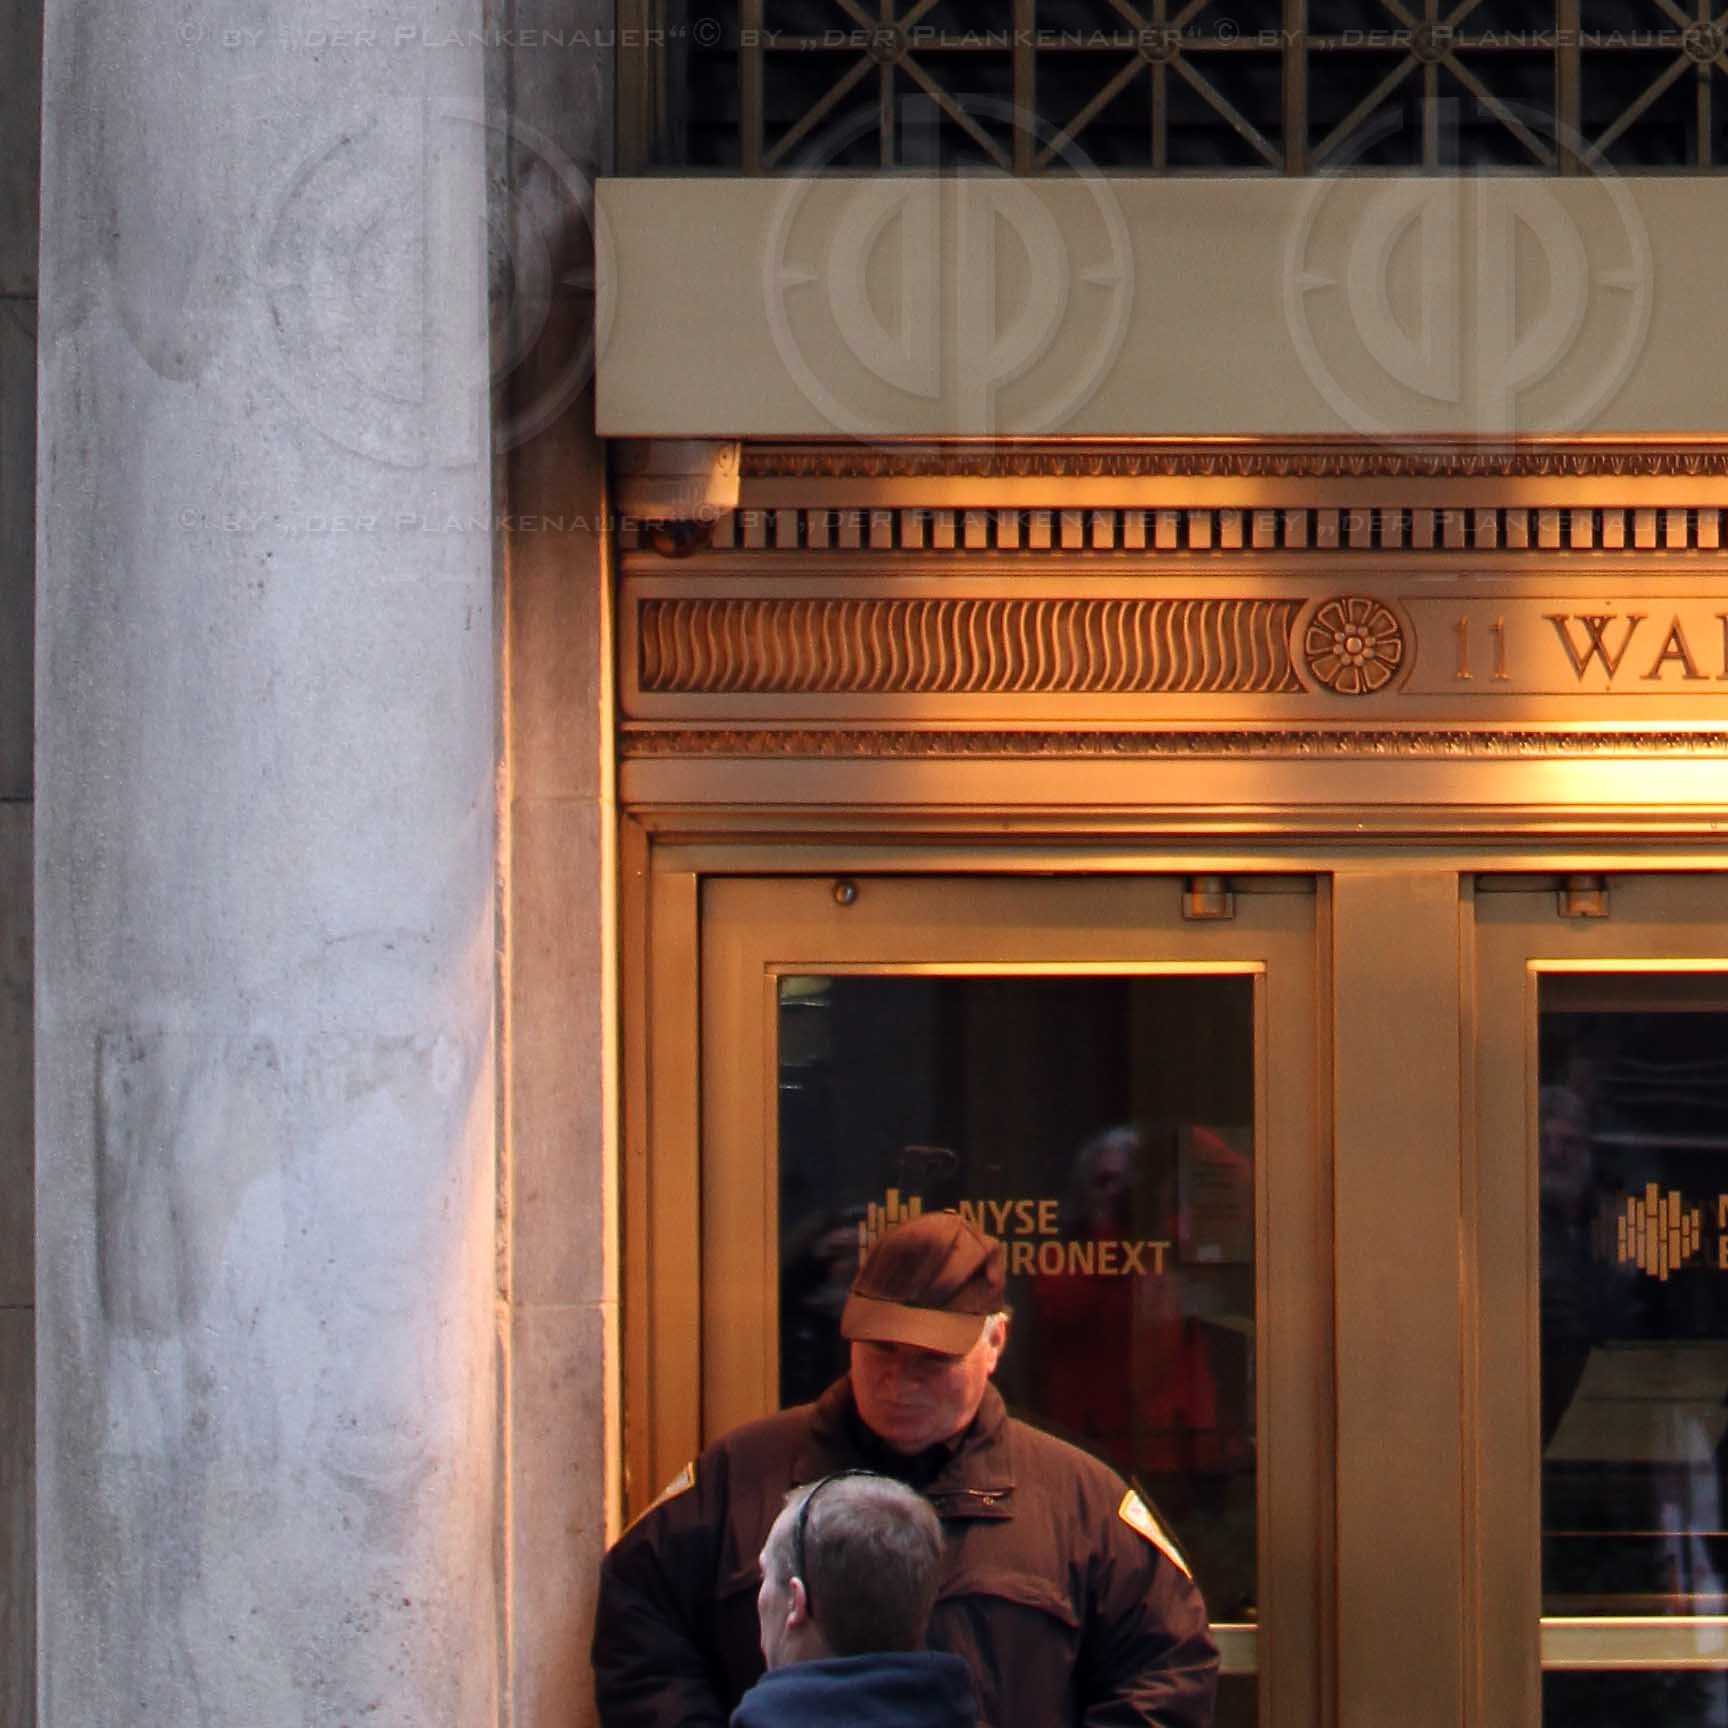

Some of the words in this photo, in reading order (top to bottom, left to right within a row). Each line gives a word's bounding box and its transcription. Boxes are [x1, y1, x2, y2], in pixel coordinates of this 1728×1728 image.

[1453, 614, 1512, 681] 11
[957, 1199, 1059, 1236] NYSE
[1000, 1240, 1171, 1277] RONEXT
